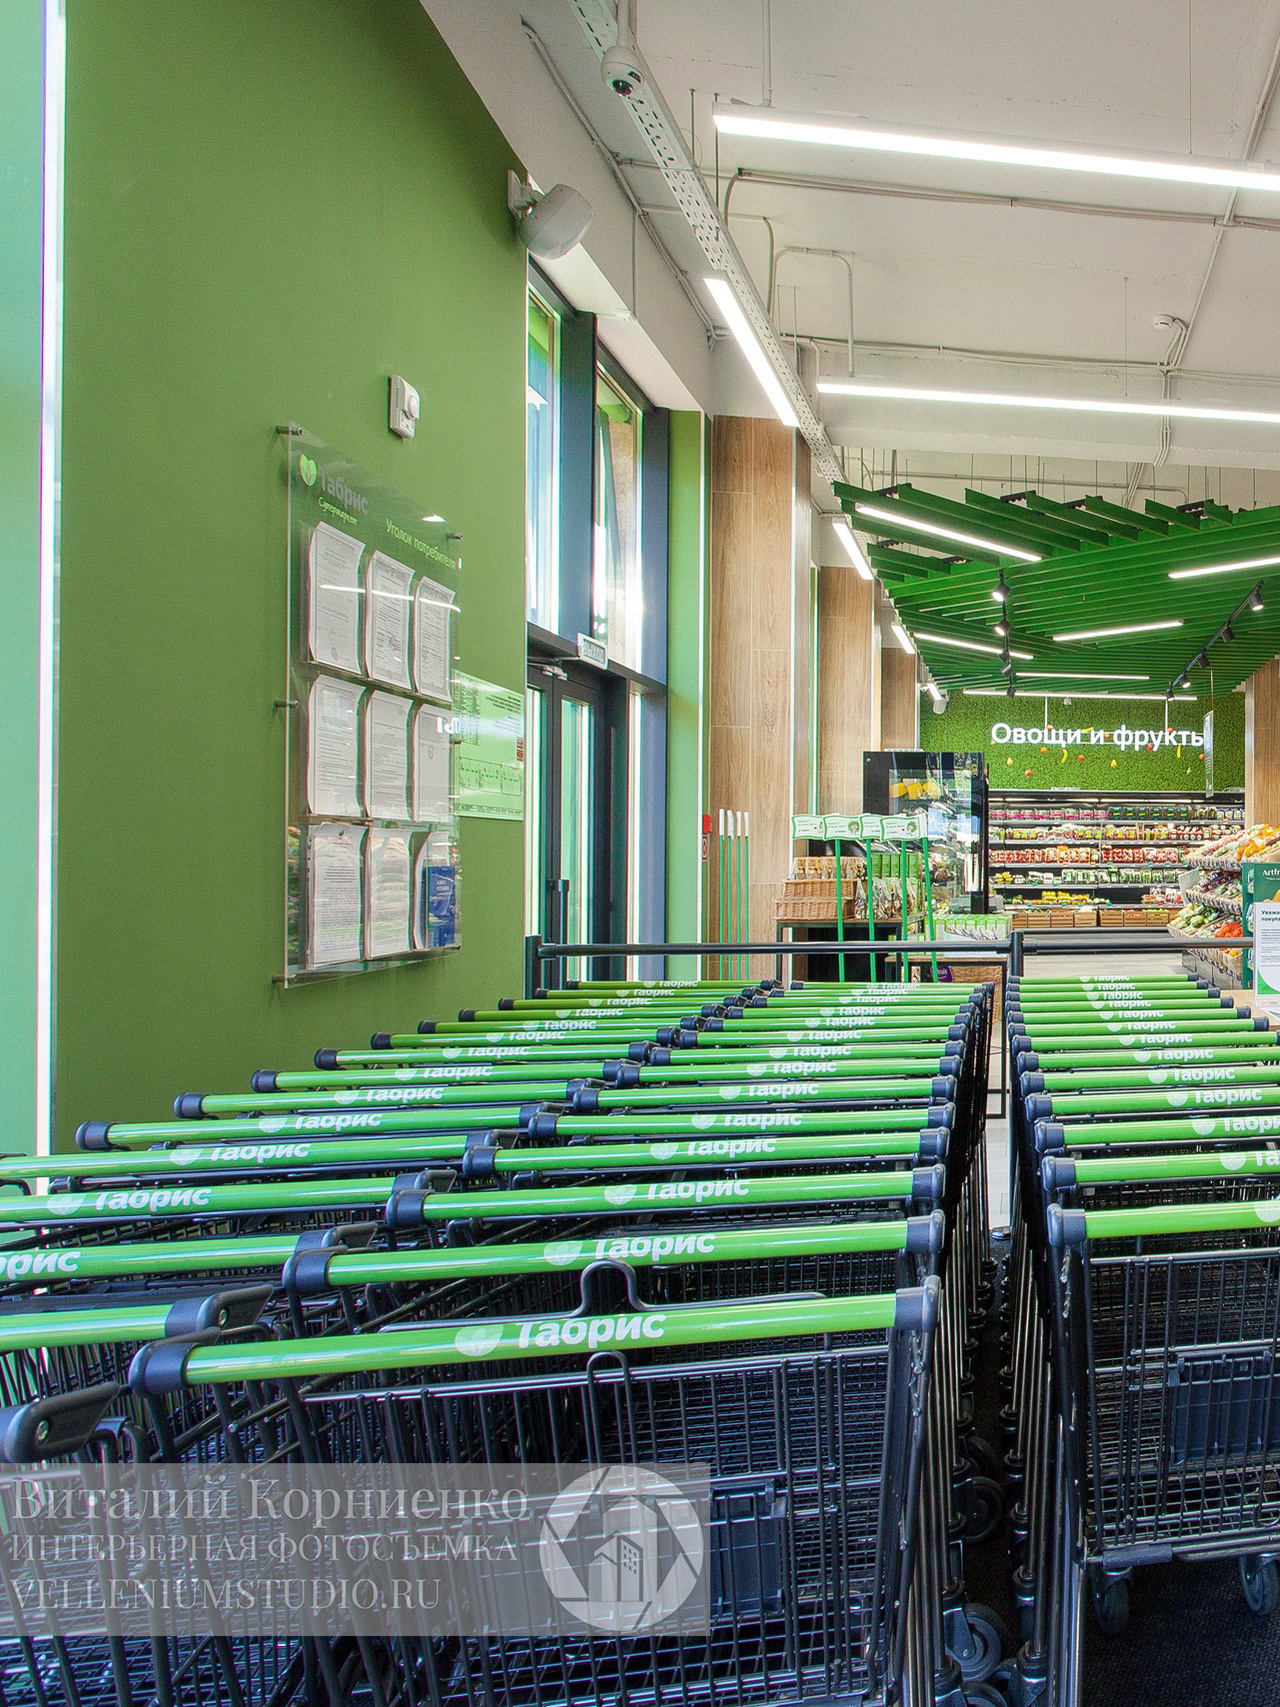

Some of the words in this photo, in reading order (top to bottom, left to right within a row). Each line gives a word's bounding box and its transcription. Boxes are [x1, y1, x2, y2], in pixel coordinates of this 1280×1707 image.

[319, 465, 369, 515] Табрис
[386, 518, 413, 546] Уголок
[414, 539, 457, 570] потребителя
[991, 722, 1082, 748] Овощи
[1090, 728, 1104, 744] и
